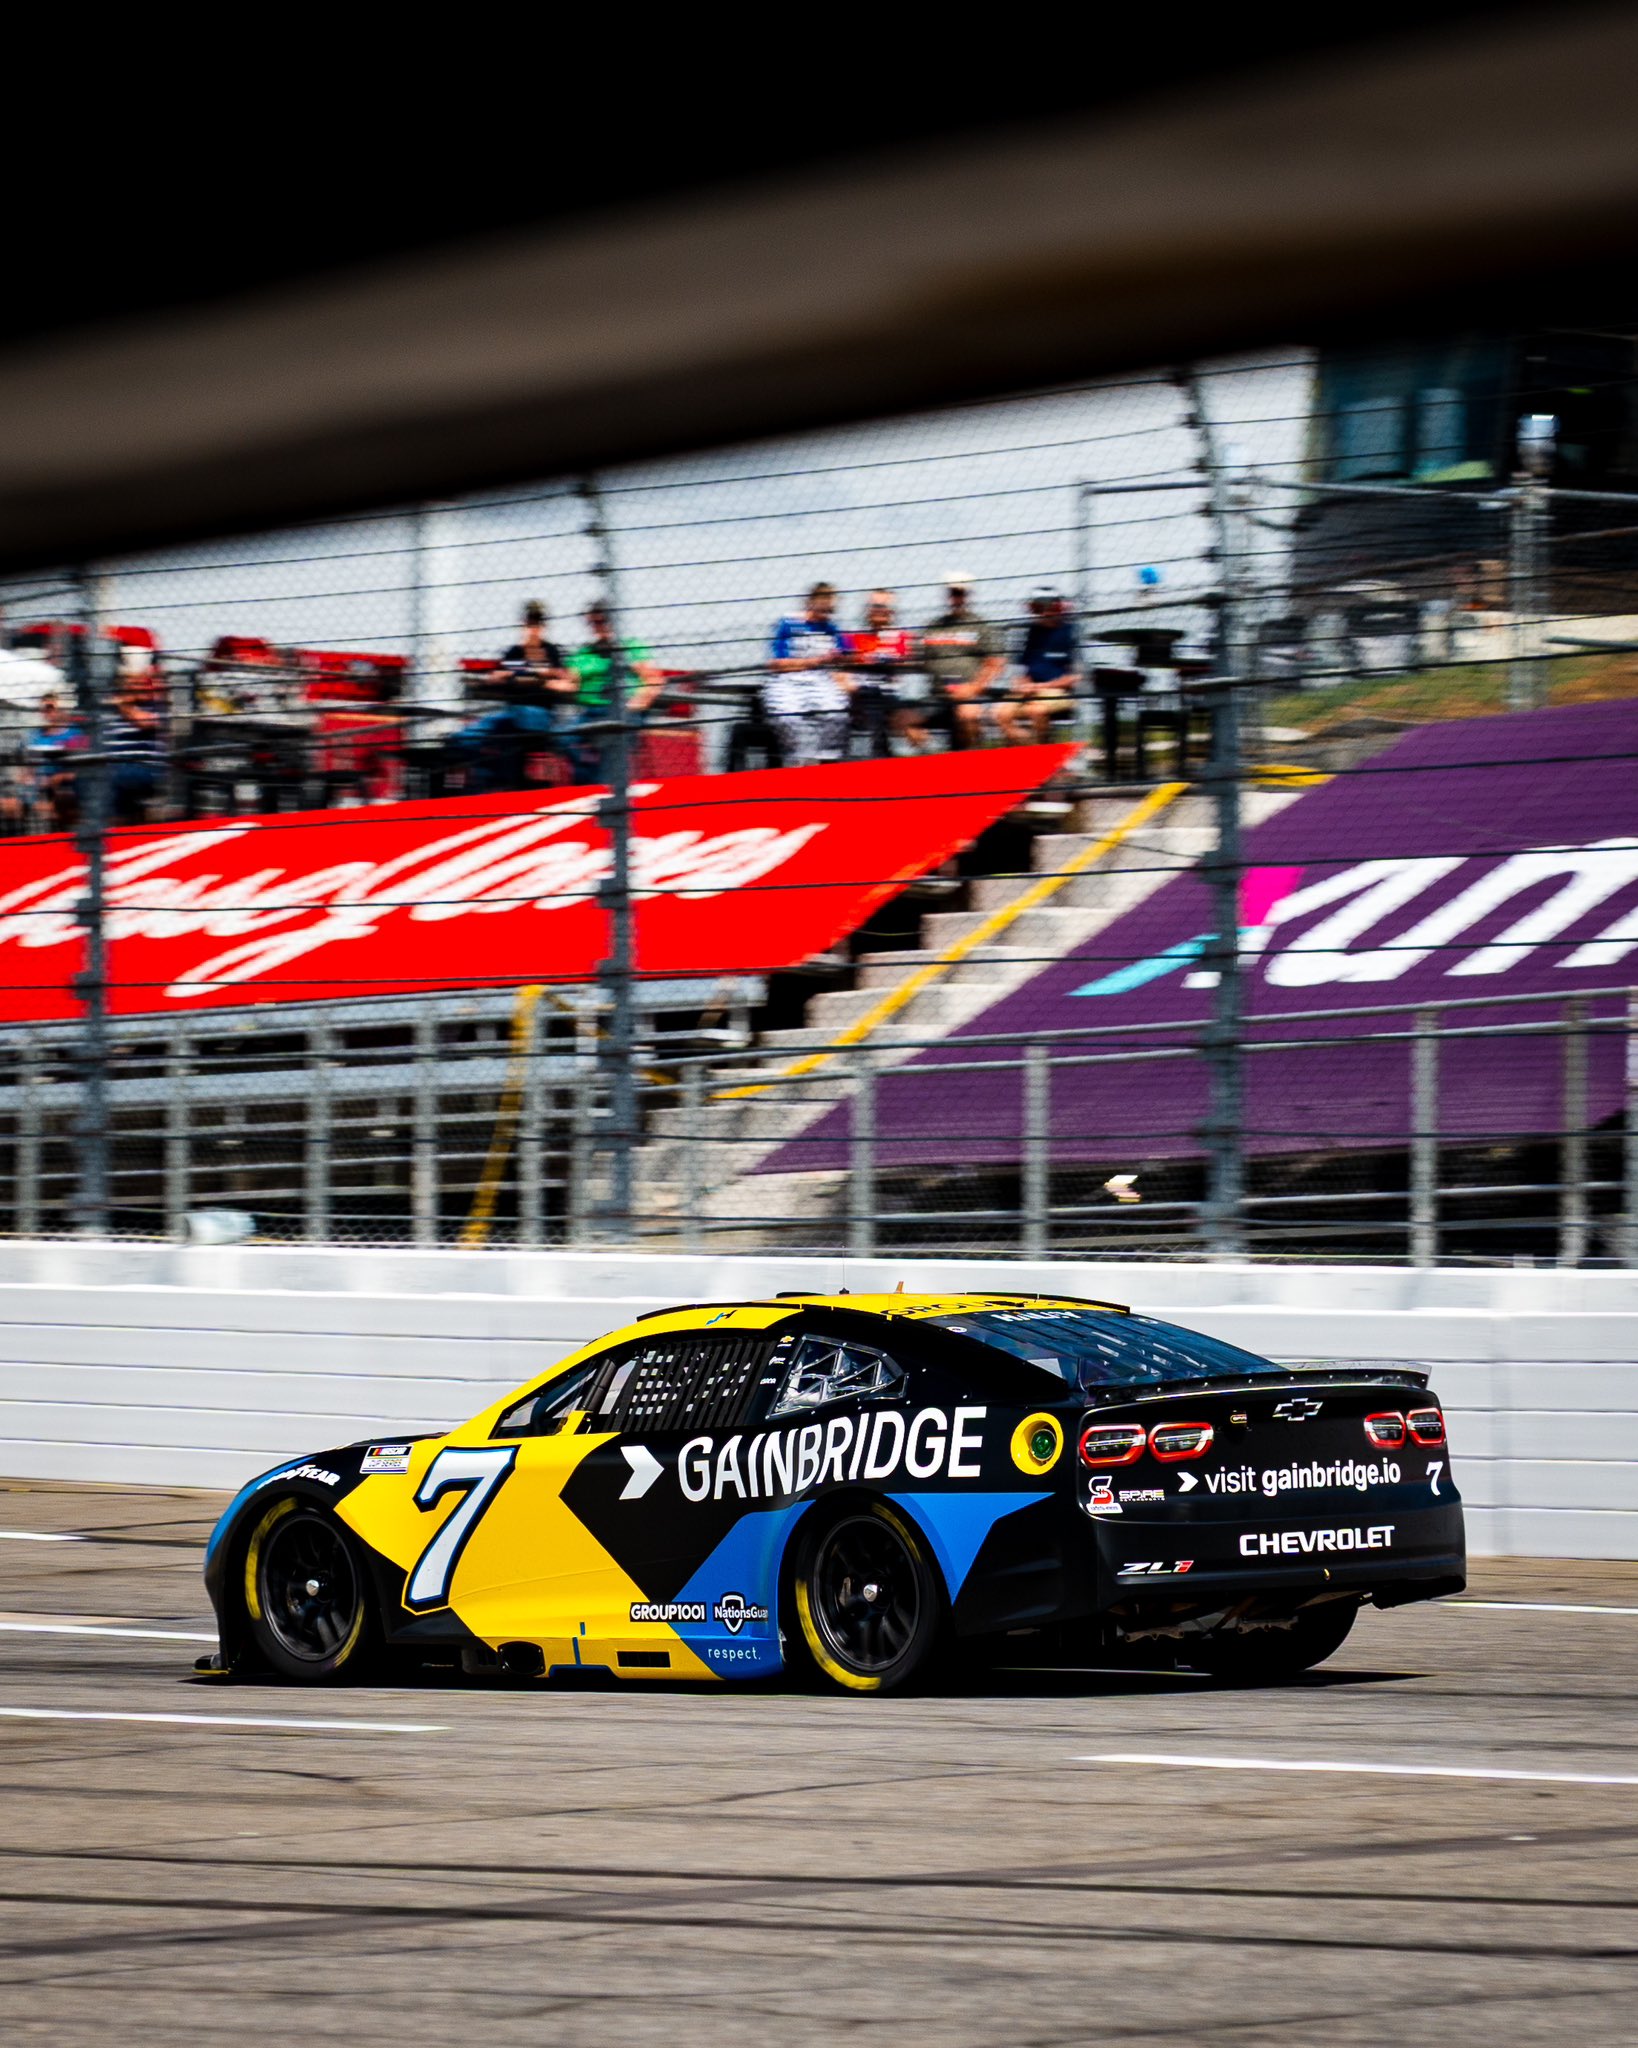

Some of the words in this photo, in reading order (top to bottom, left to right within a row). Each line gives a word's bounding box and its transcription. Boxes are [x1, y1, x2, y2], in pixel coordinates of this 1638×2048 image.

[677, 1406, 987, 1502] GAINBRIDGE
[1204, 1466, 1257, 1494] visit
[1261, 1457, 1401, 1497] gainbridge.io
[1425, 1460, 1444, 1496] 7
[406, 1446, 518, 1611] 7
[1239, 1525, 1395, 1556] CHEVROLET
[630, 1604, 705, 1620] GROUP1001
[708, 1647, 761, 1661] respect.
